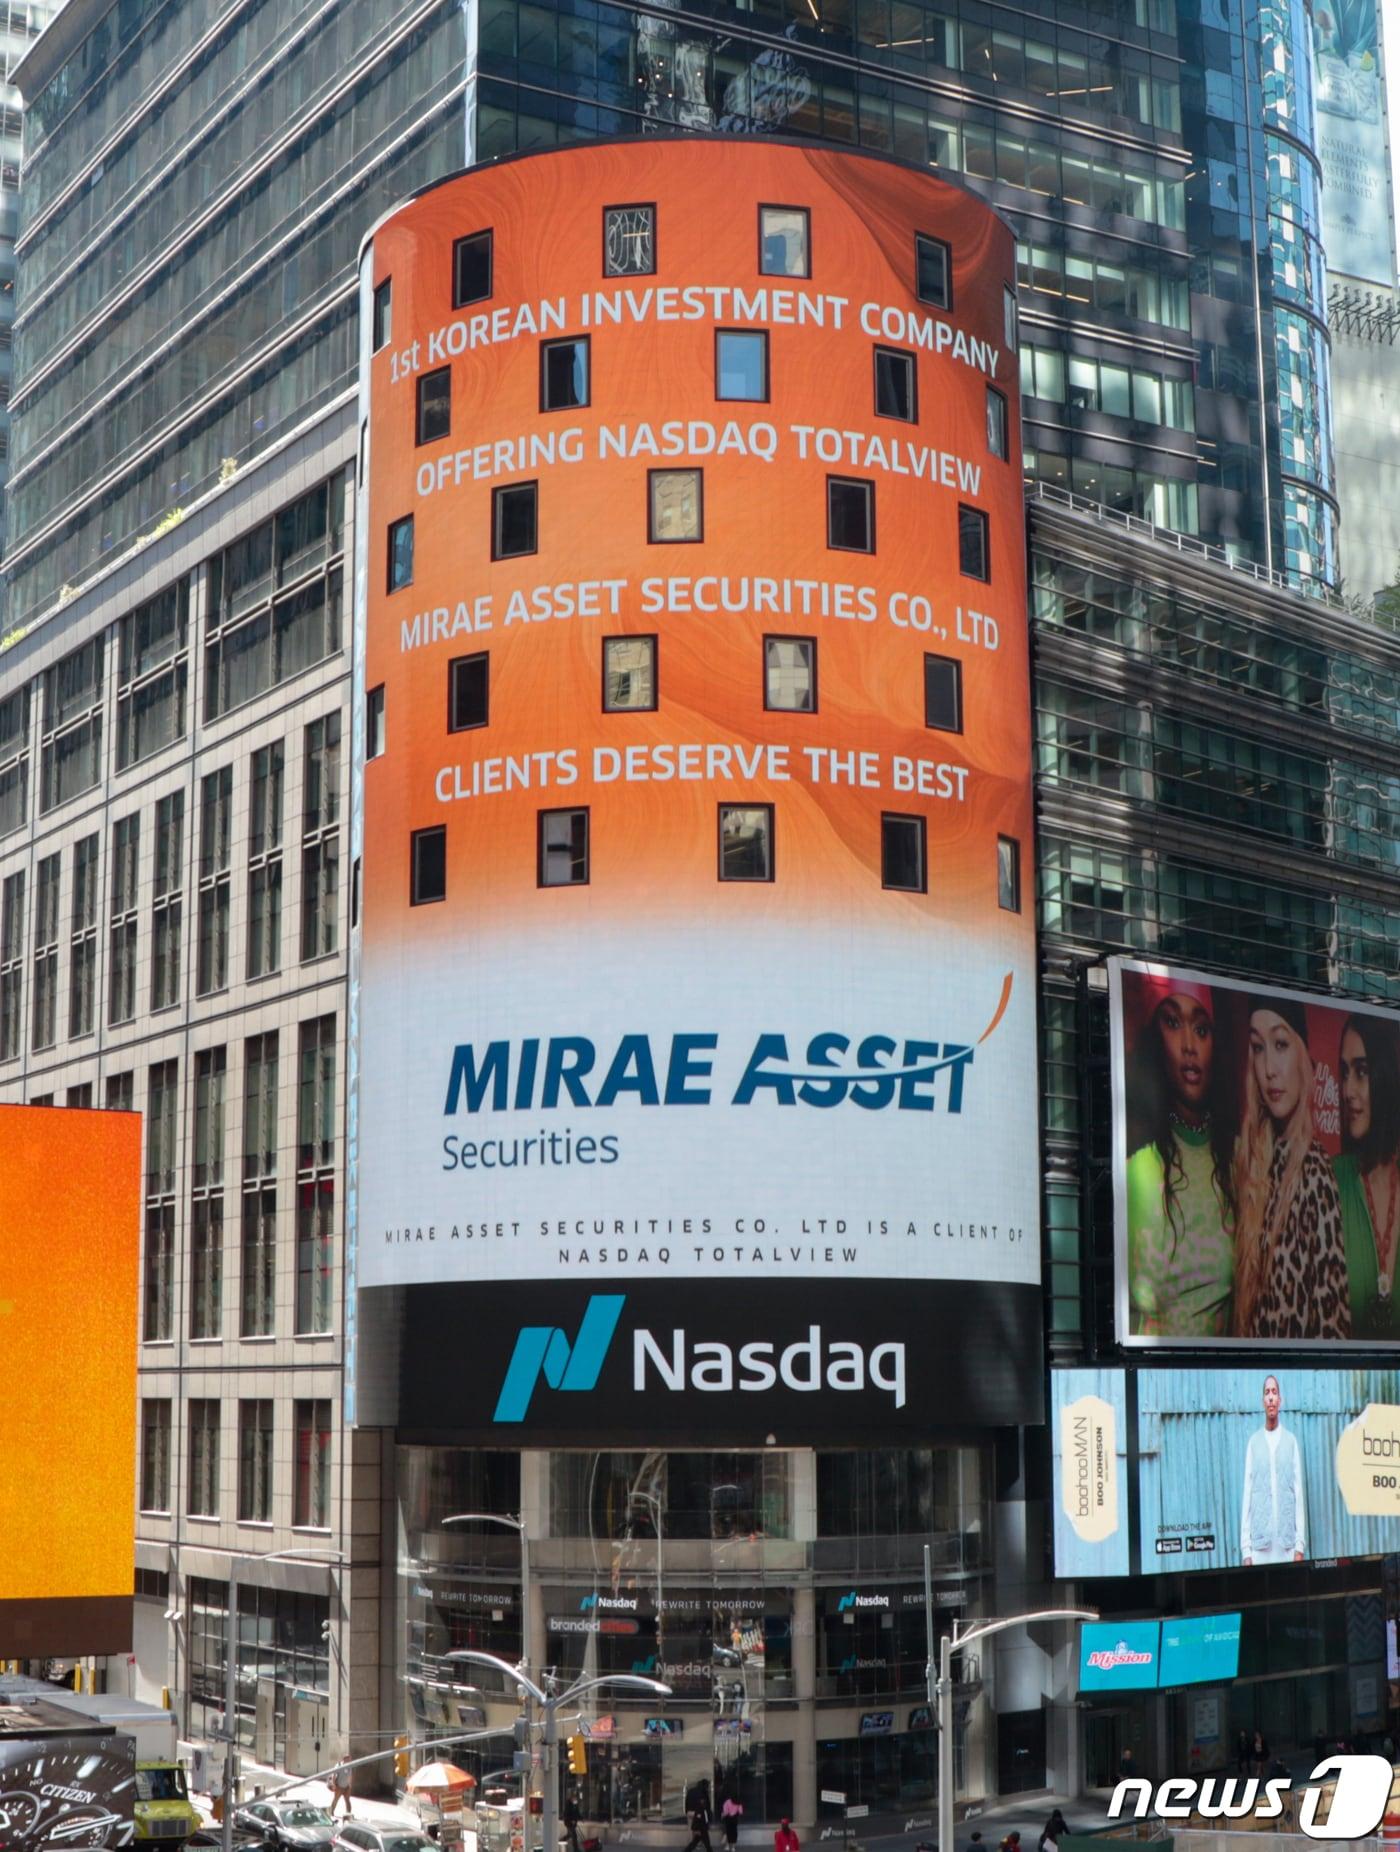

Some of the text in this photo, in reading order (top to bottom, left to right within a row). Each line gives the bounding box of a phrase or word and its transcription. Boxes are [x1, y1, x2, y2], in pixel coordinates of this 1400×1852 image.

[1323, 162, 1379, 188] ASTERFULLY
[390, 286, 999, 384] 1st KOREAN INVESTMENT COMPANY
[416, 421, 981, 496] OFFERING NASDAQ TOTALVIEW
[400, 576, 1000, 652] MIRAE ASSET SECURITIES CO., LTD
[435, 744, 969, 802] CLIENTS DESERVE THE BEST
[444, 1032, 974, 1116] MIRAE ASSET
[442, 1128, 619, 1171] Securities
[385, 1219, 1023, 1243] MIRAE ASSET SECURITIES CO. LTD IS A CLIENT OF
[559, 1247, 857, 1263] NASDAQ TOTALVIEW
[633, 1325, 905, 1409] Nasdaq
[1073, 1416, 1088, 1517] boohooMAN
[1096, 1426, 1104, 1507] BOO JOHNSON
[1372, 1475, 1397, 1489] BOO
[598, 1597, 638, 1610] Nasdaq
[706, 1600, 765, 1610] TOMORROW
[855, 1595, 889, 1607] Nasdaq
[656, 1662, 711, 1676] Nasdaq
[1086, 1651, 1152, 1670] Mission
[40, 1784, 96, 1803] CITIZEN
